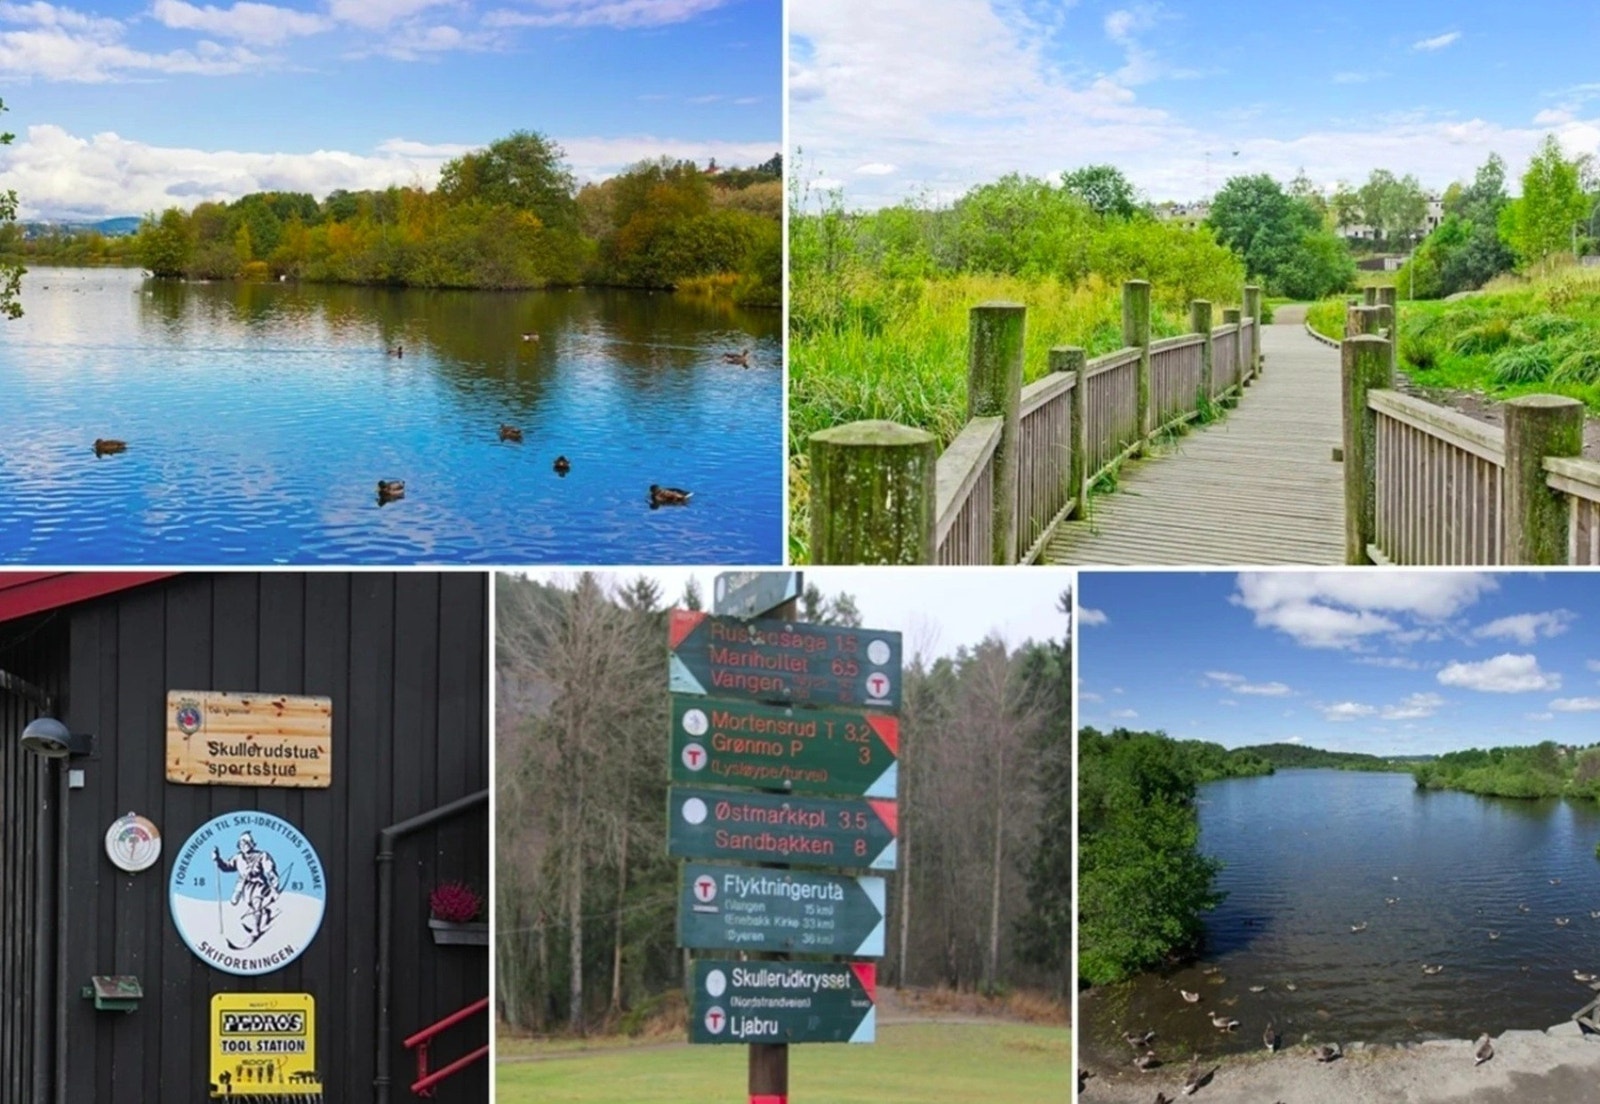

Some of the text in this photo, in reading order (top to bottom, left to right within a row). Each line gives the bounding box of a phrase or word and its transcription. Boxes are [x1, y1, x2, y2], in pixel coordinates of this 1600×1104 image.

[831, 660, 860, 677] 6.5
[711, 670, 784, 693] Vangen
[712, 711, 871, 743] Mortensrud T 3.2
[208, 740, 320, 759] Skullerudstua
[712, 733, 871, 765] Grønmo P 3
[208, 762, 297, 777] sportsstue
[838, 811, 867, 831] 3.5
[175, 816, 322, 890] FORENINGEN TIL SKI-IDRETTENS FREMME
[714, 830, 867, 857] Sandbakken 8
[193, 877, 206, 887] 18
[724, 874, 844, 901] Flyktningeruta
[198, 940, 295, 970] SKIFORENINGEN
[731, 967, 851, 993] Skullerudkrysset
[224, 1013, 303, 1033] PEDRO'S
[730, 1016, 778, 1039] Ljabru
[221, 1040, 305, 1052] TOOL STATION
